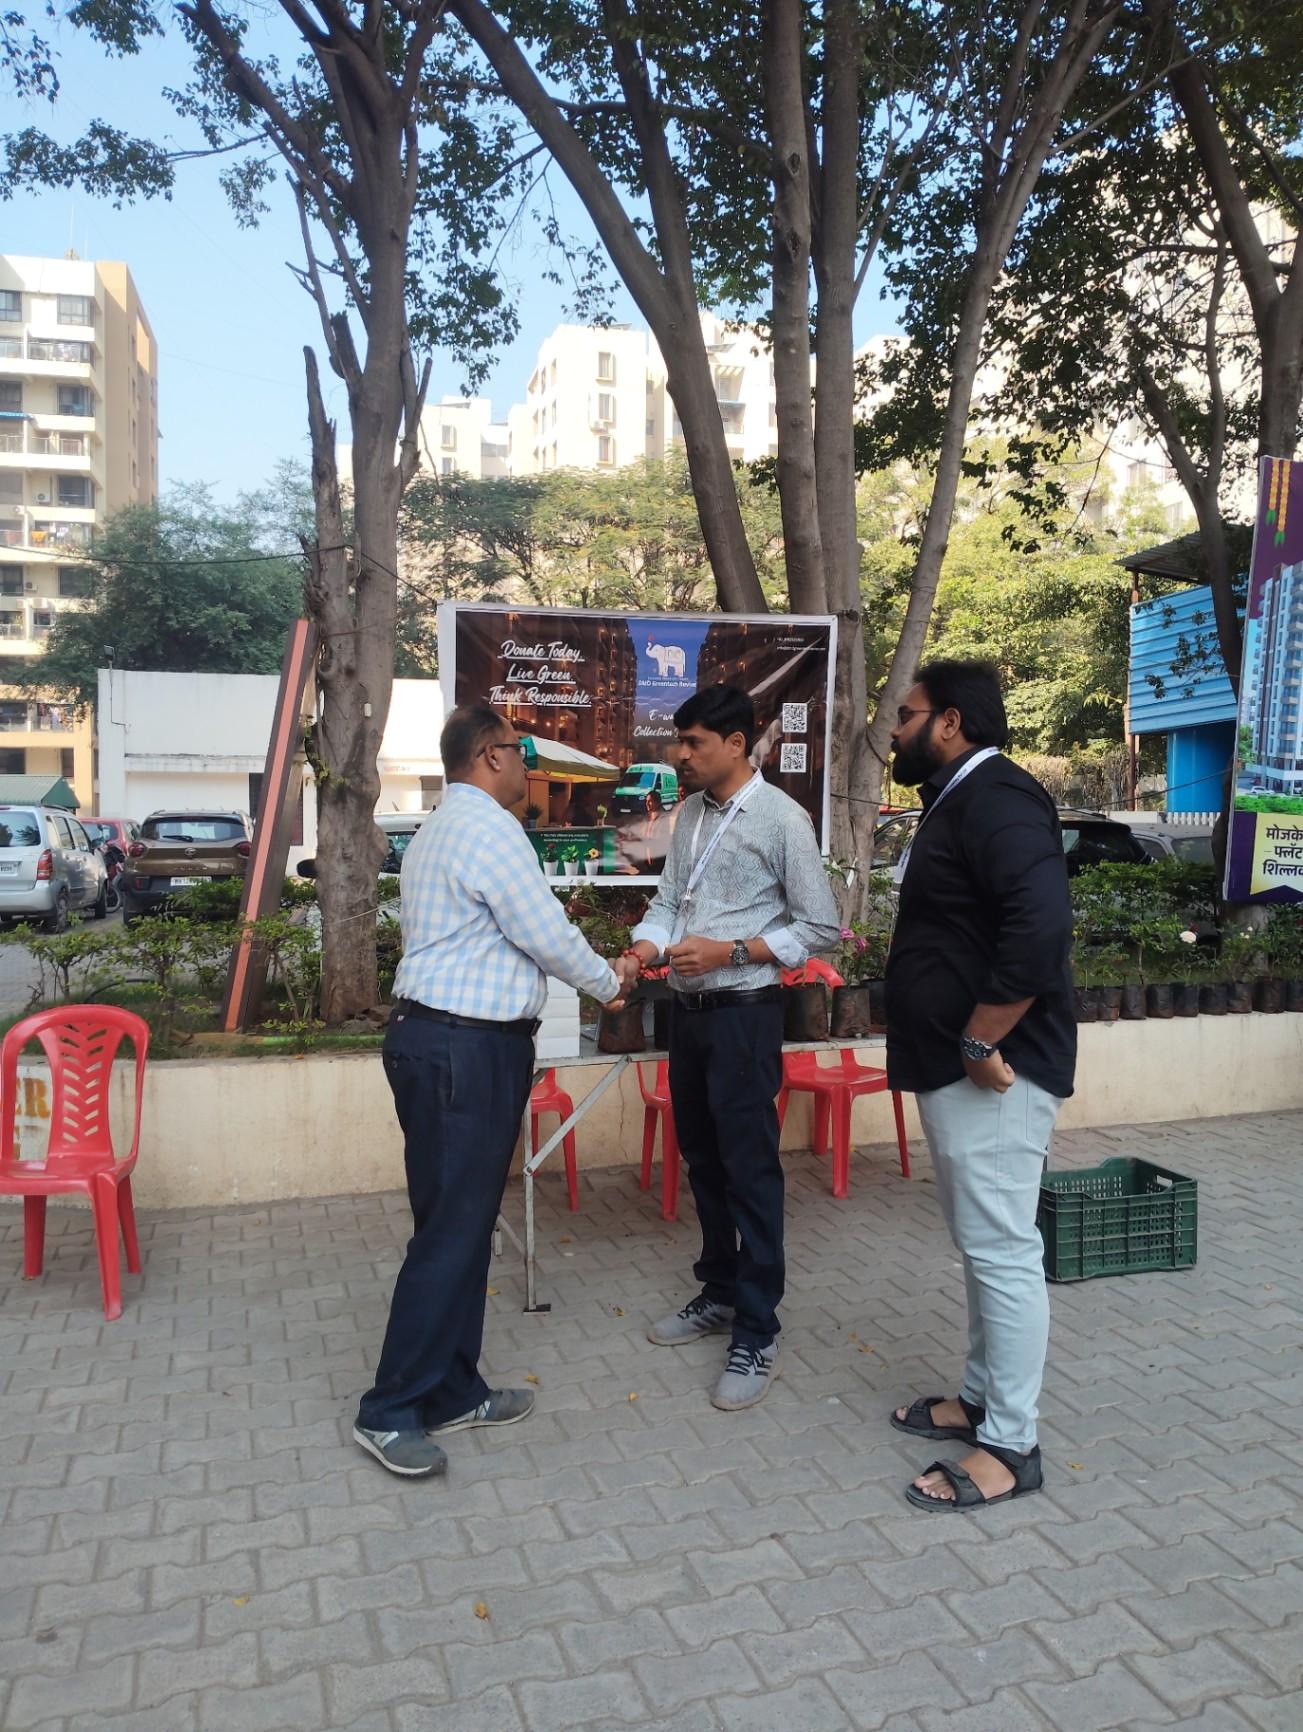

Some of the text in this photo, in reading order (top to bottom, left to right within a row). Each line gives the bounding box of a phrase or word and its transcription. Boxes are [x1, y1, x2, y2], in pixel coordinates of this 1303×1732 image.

[501, 640, 545, 657] Donate
[507, 663, 574, 684] Live Green.
[489, 685, 592, 706] Think Responsible.
[633, 725, 673, 737] Collection
